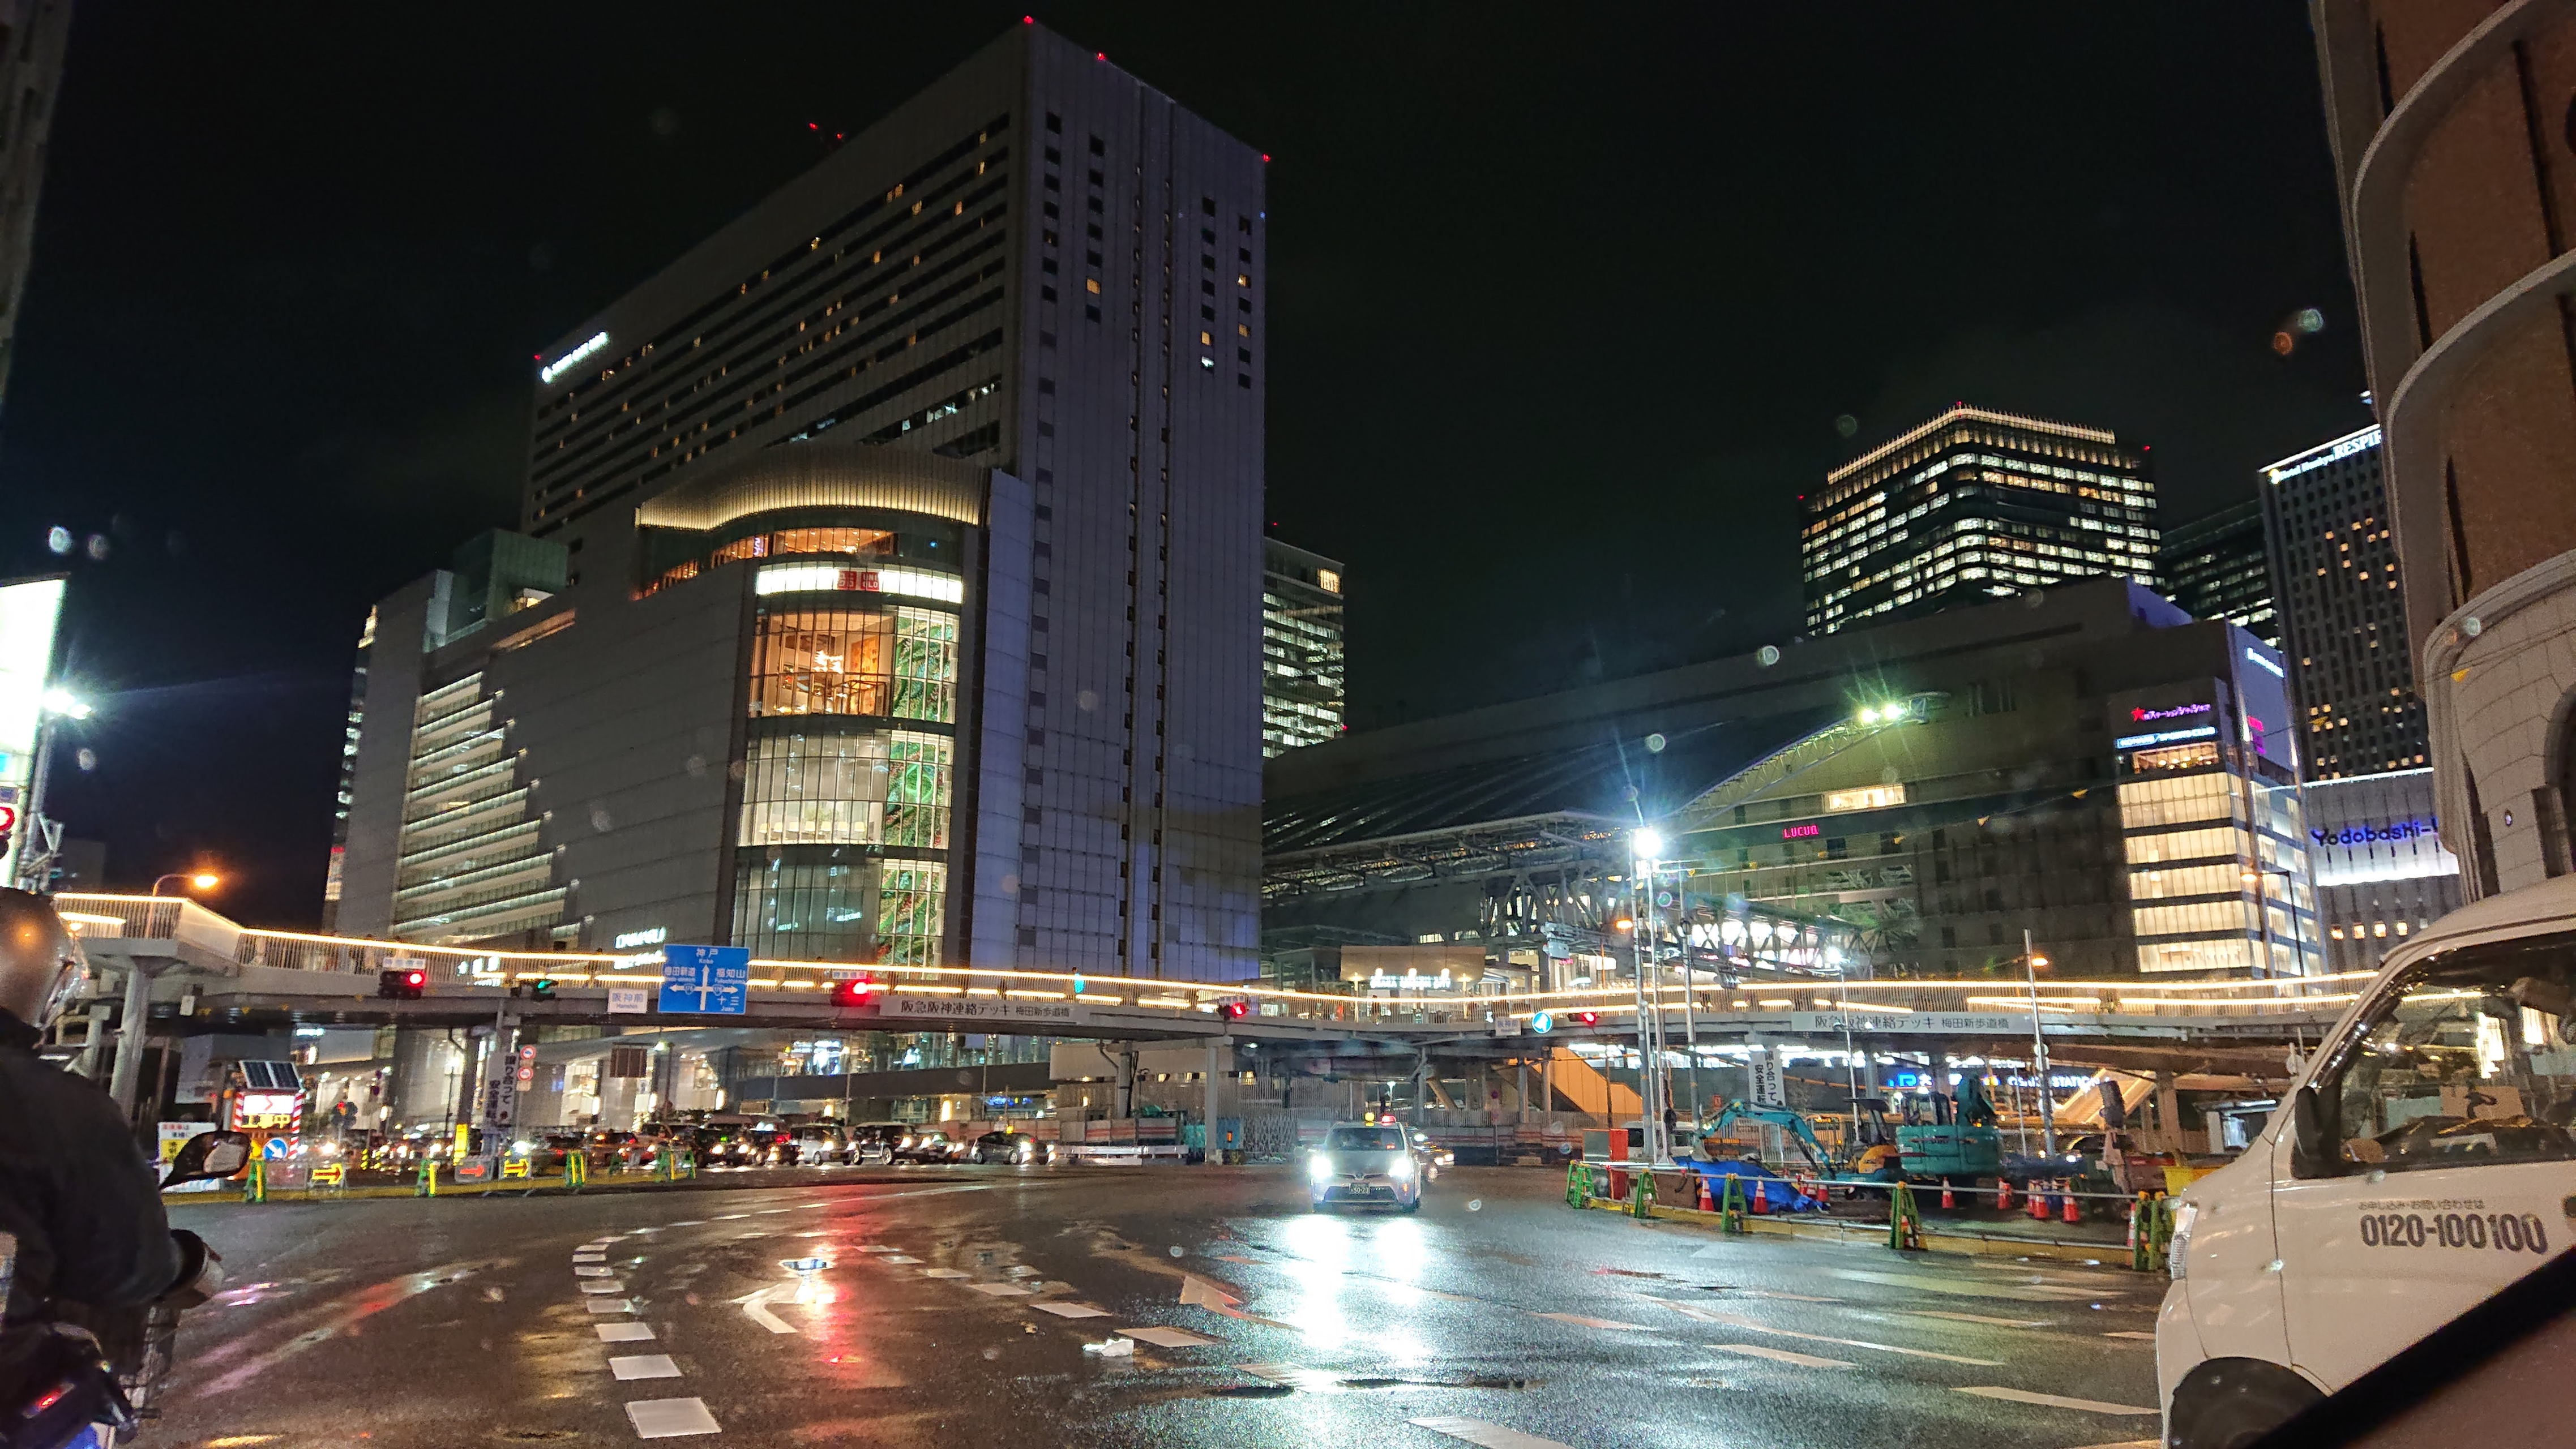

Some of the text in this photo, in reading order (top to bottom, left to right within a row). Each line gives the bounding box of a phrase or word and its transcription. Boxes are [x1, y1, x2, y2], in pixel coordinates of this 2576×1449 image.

[696, 948, 718, 958] 神戸
[716, 968, 746, 979] 福知山
[612, 993, 644, 1002] 阪神前
[717, 996, 739, 1006] 十三
[901, 1000, 1069, 1018] 阪急阪神連絡デッキ 梅田新歩道橋
[1941, 1018, 2010, 1029] 梅田新歩道橋
[1755, 1064, 1766, 1104] 安全運転
[2360, 1214, 2548, 1255] 0120-100100
